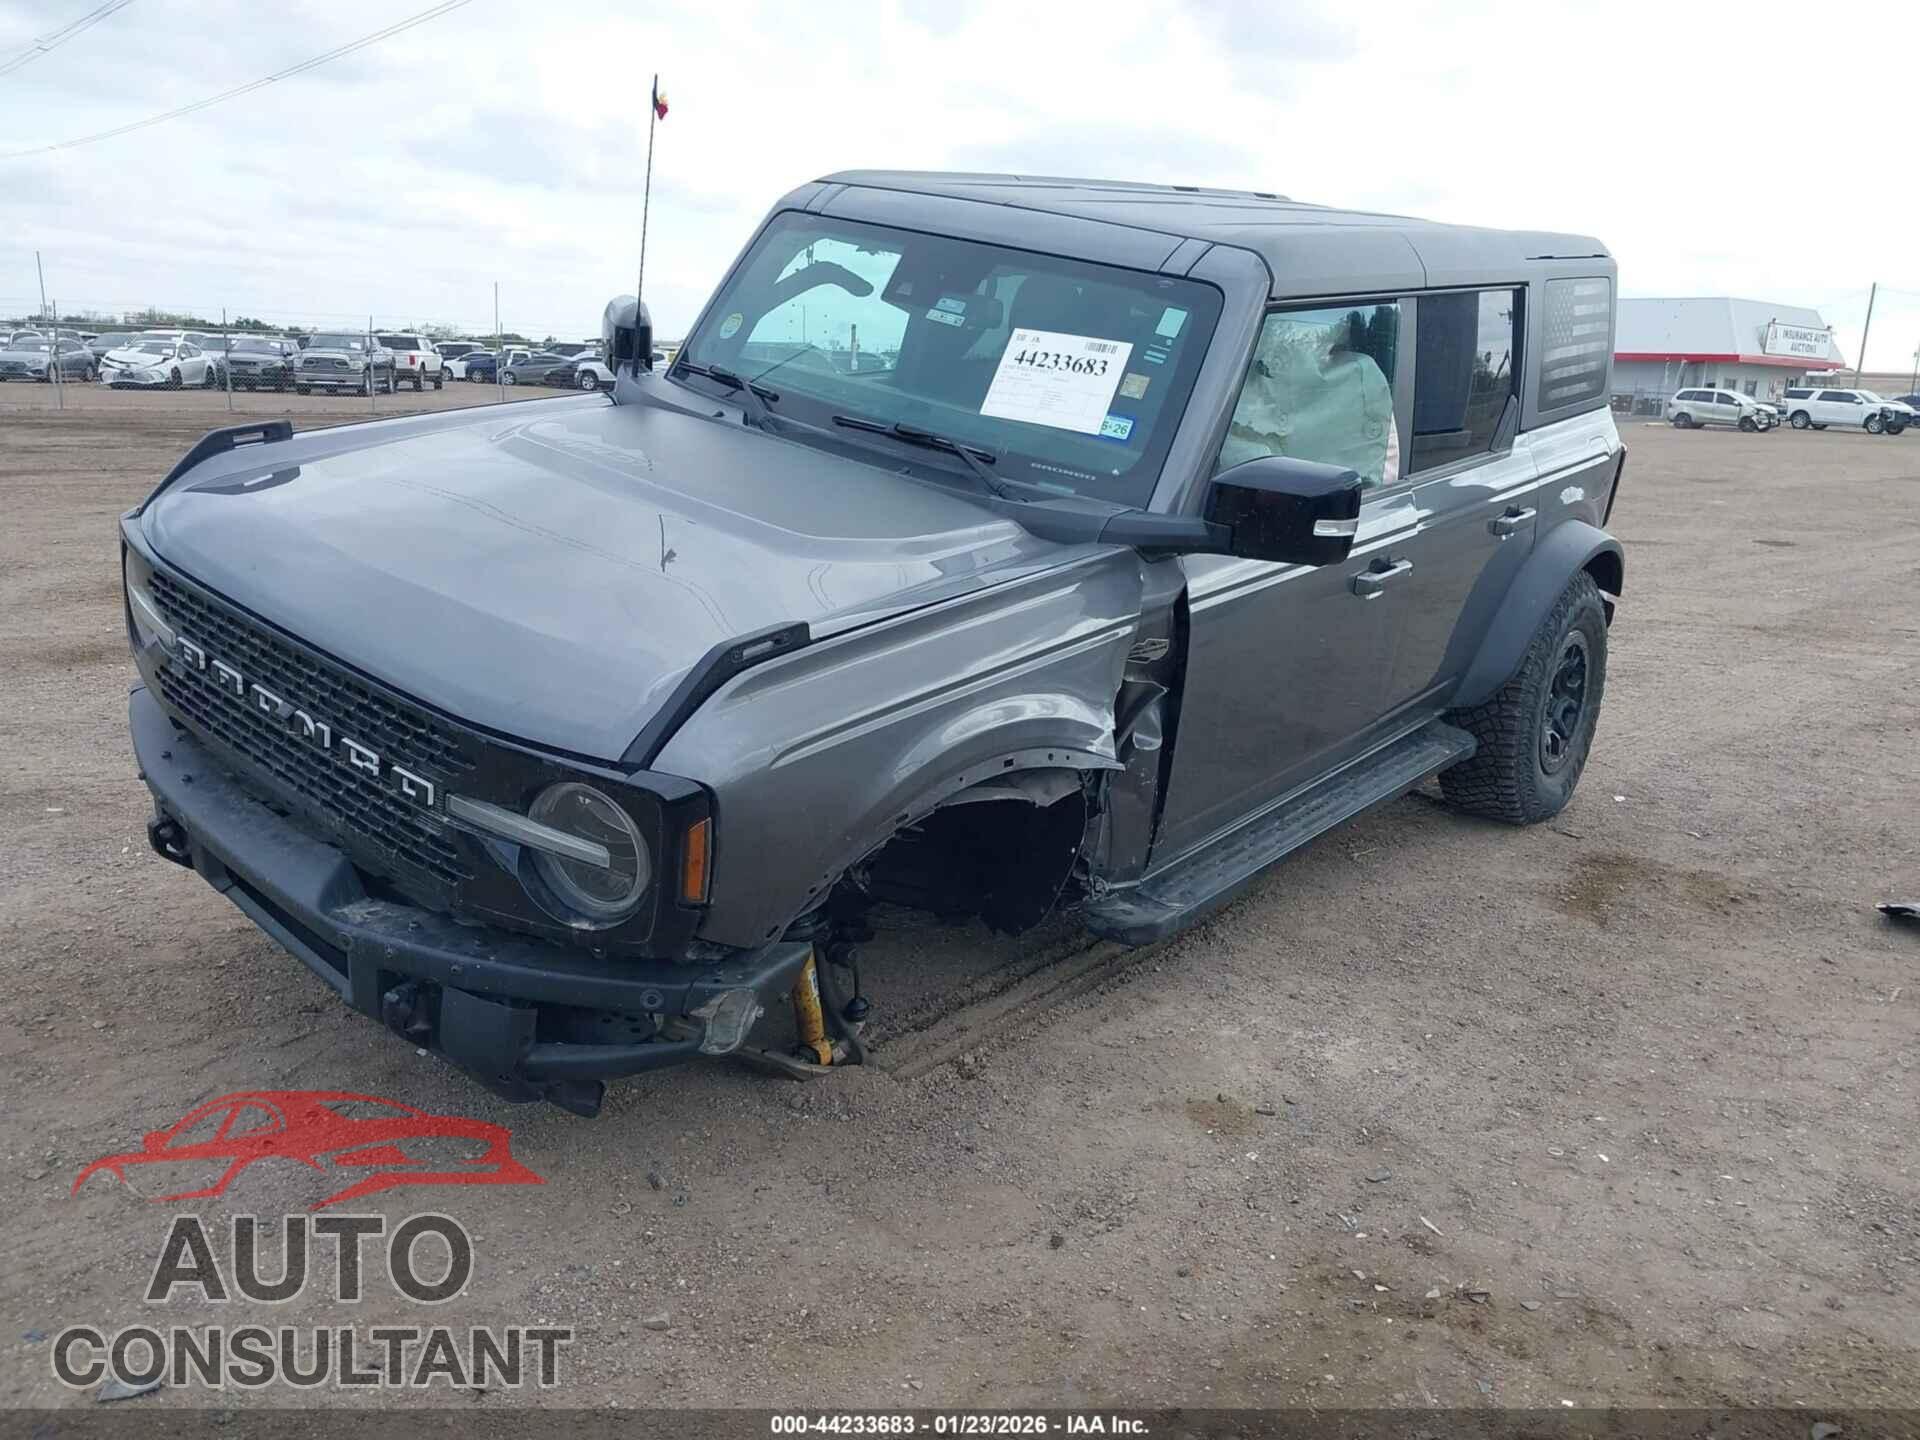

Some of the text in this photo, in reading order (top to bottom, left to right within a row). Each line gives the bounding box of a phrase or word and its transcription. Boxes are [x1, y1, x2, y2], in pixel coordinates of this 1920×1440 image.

[1814, 332, 1828, 344] AUTO
[1014, 349, 1108, 376] 44233683
[176, 637, 434, 806] BRONCO
